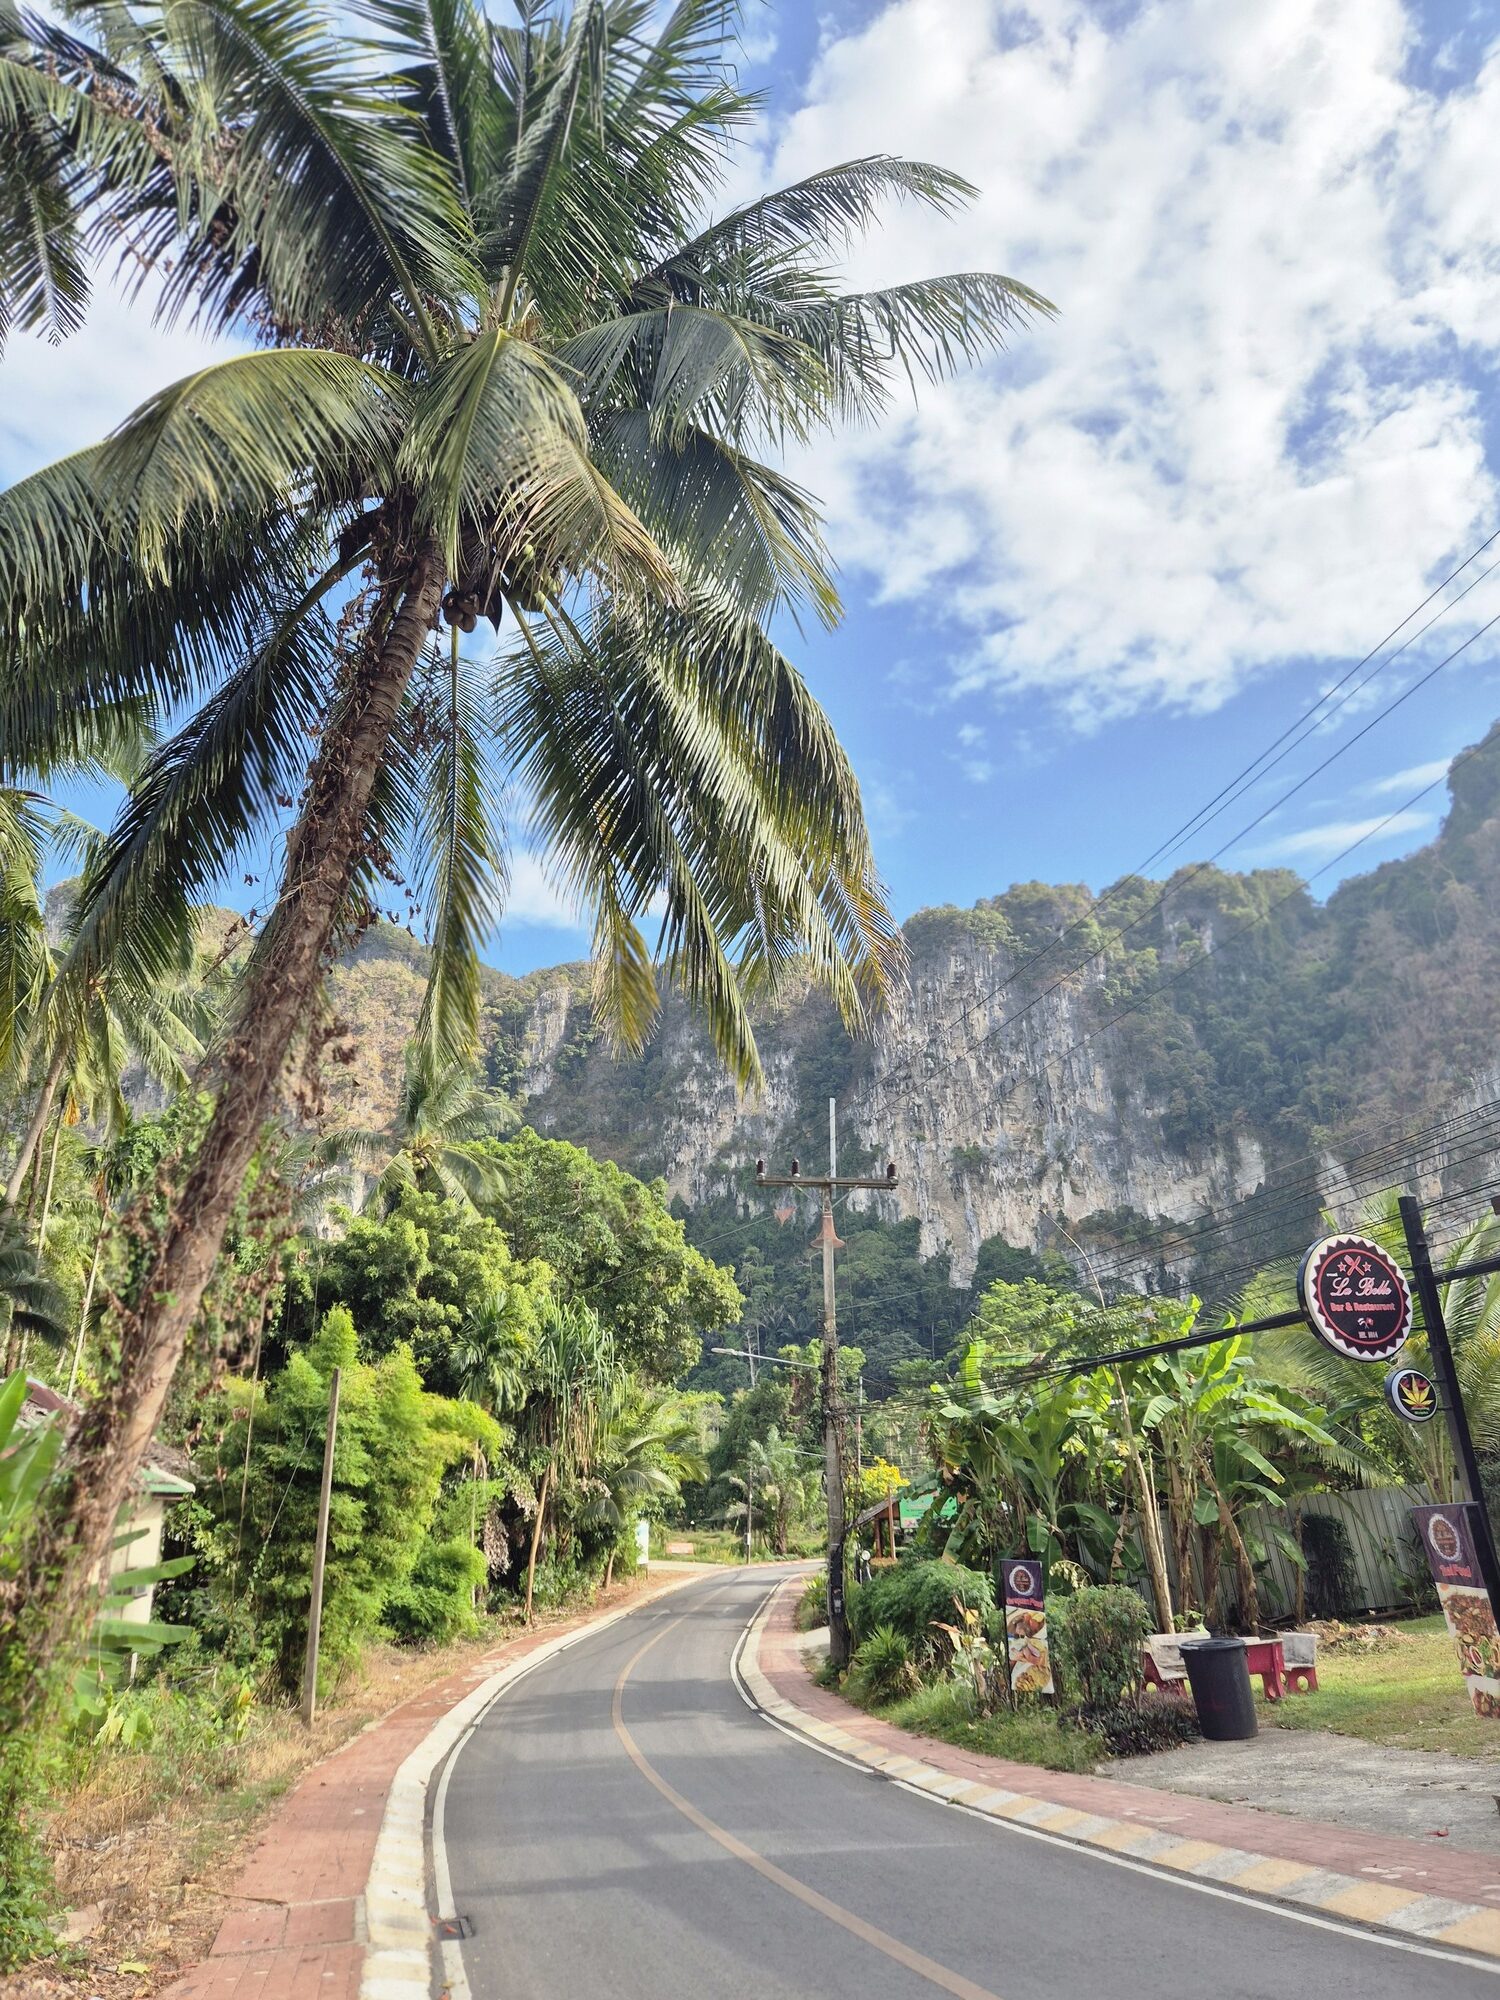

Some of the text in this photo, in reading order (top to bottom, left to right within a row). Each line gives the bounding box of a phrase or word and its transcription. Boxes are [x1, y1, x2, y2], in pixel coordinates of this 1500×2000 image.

[1330, 1277, 1392, 1296] La Belle
[1330, 1302, 1344, 1312] Bar
[1353, 1302, 1396, 1312] Restaurant
